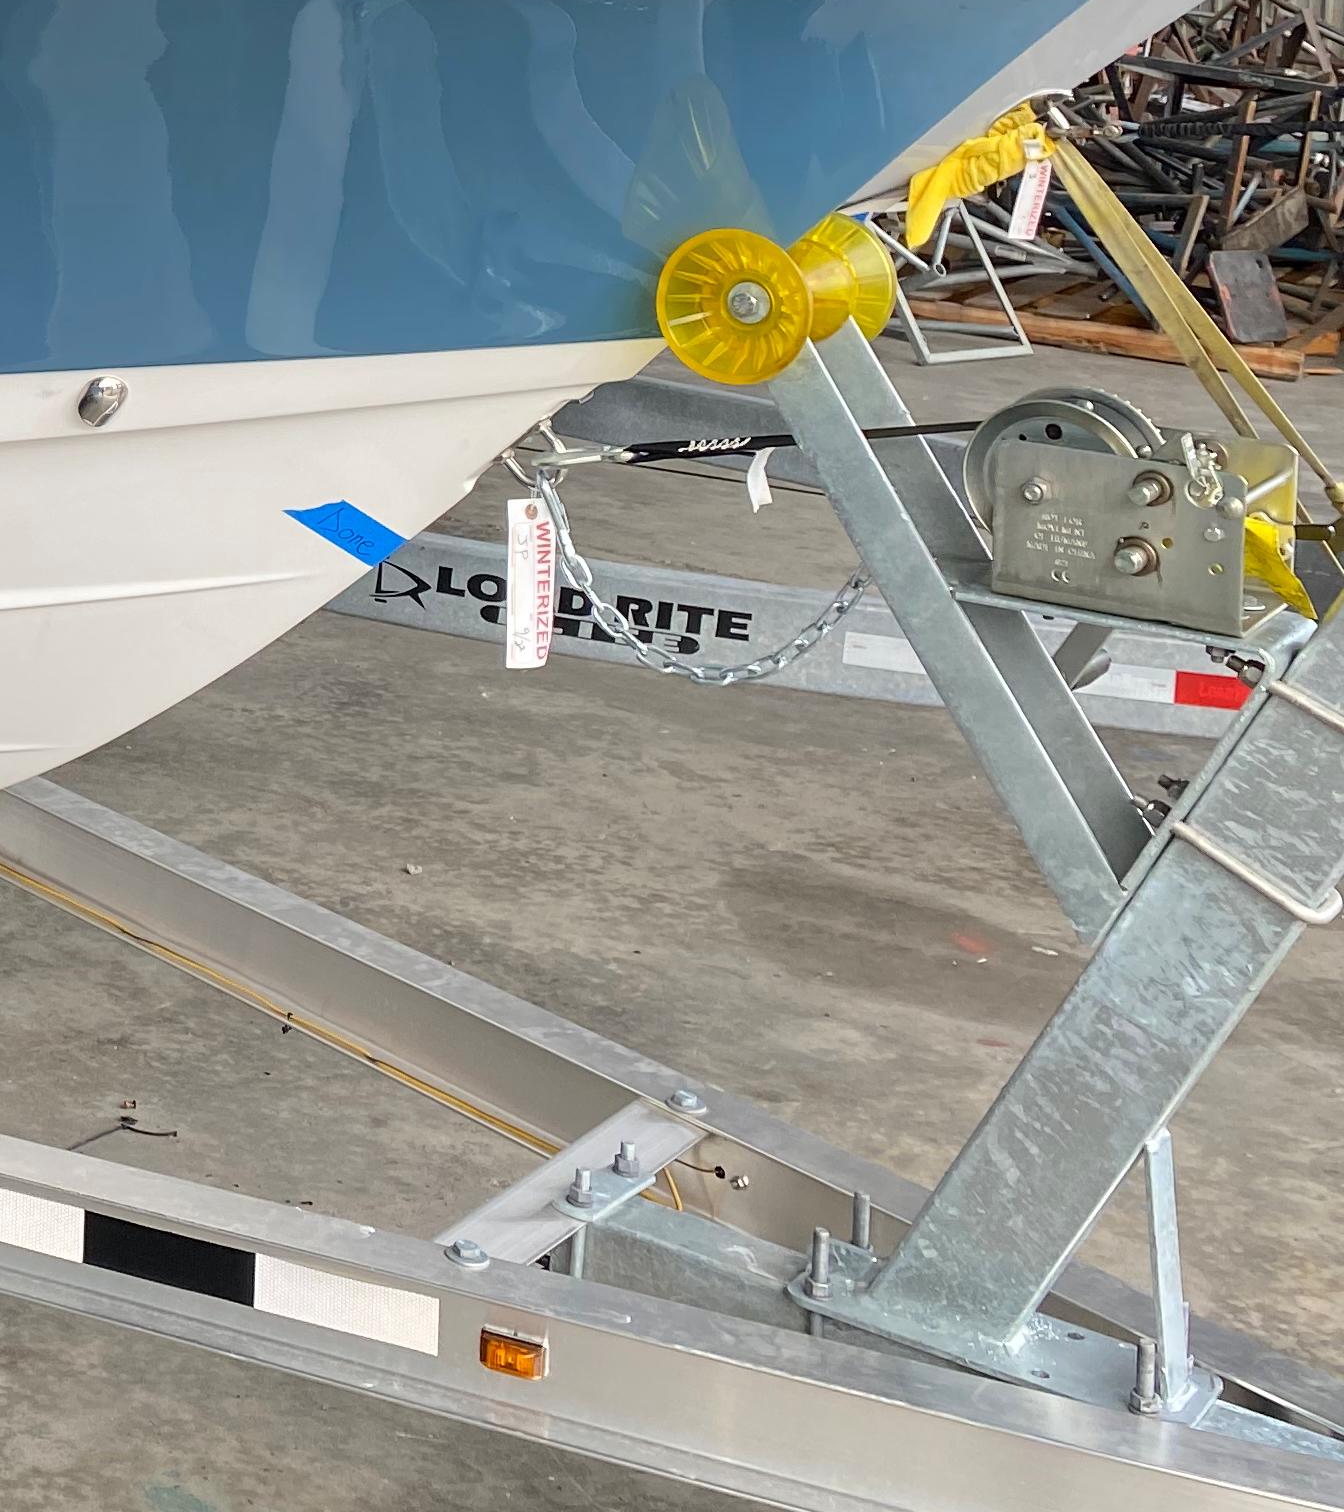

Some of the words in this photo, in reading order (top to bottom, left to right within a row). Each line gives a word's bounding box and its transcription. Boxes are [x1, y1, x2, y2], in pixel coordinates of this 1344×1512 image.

[1024, 165, 1049, 237] WINTERIZED
[316, 507, 375, 557] Done
[436, 565, 593, 617] LOD
[616, 595, 753, 642] RITE
[535, 521, 552, 661] WINTERIZED
